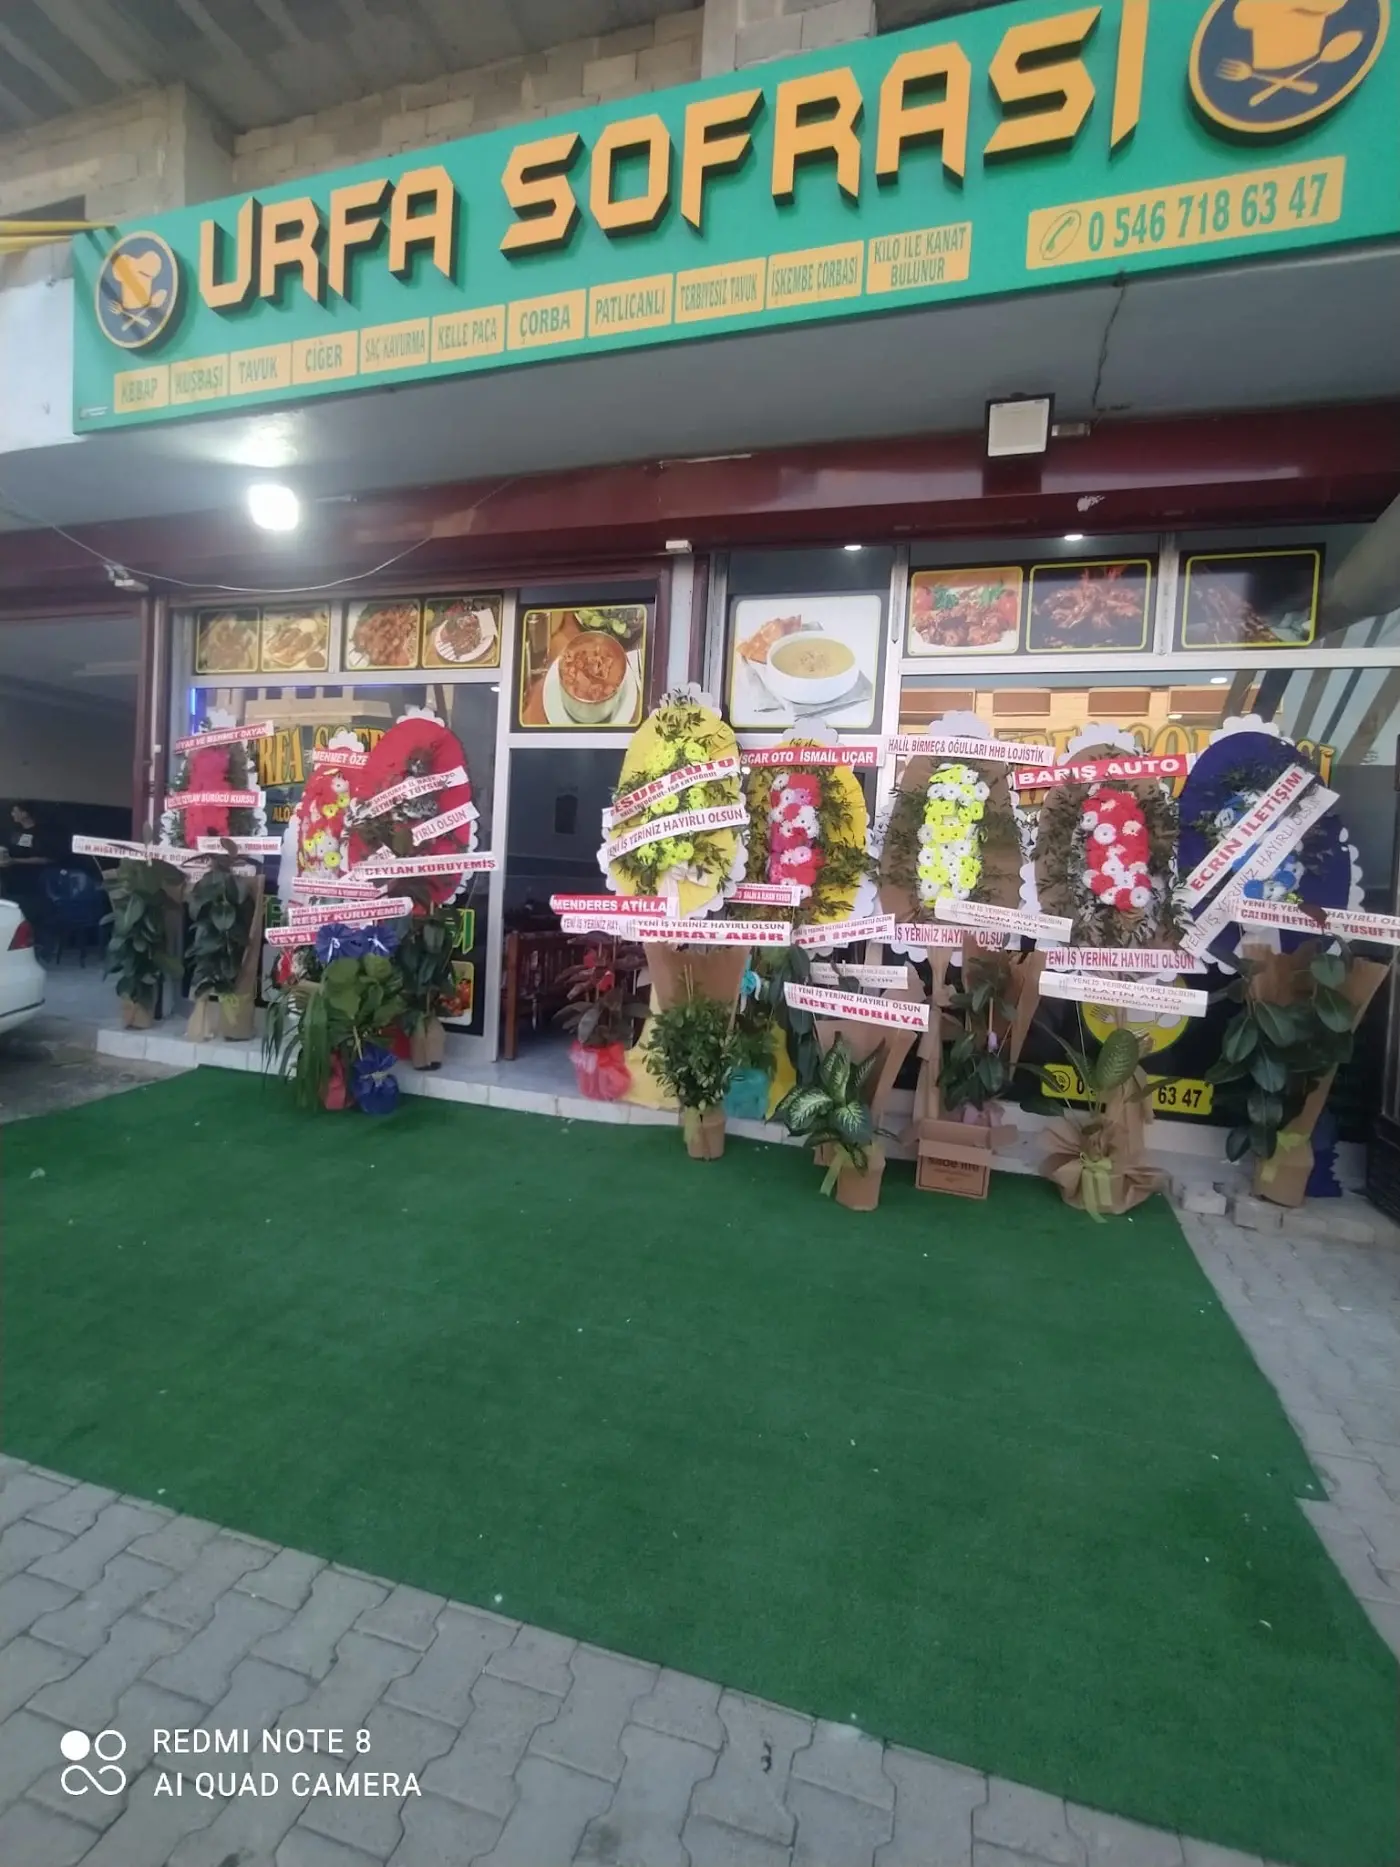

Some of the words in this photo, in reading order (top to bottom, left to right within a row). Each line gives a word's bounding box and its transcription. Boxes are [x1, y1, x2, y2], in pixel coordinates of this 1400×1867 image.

[200, 165, 455, 308] URFA
[501, 0, 1149, 252] SOFRASI
[1088, 211, 1105, 251] 0
[1113, 201, 1166, 248] 546
[1178, 190, 1230, 238] 718
[1241, 181, 1278, 228] 63
[1288, 172, 1328, 220] 47
[926, 226, 967, 255] KANAT
[891, 257, 945, 287] BULUNUR
[730, 272, 757, 303] TAVUK
[595, 286, 665, 325] PATLICANLI
[438, 322, 468, 351] KELLE
[520, 304, 571, 344] ÇORBA
[238, 356, 278, 385] TAVUK
[312, 751, 348, 764] MEHMET
[349, 752, 368, 766] ÖZE
[771, 751, 794, 763] OTO
[799, 748, 839, 763] İSMAİL
[842, 751, 874, 766] UÇAR
[888, 738, 909, 751] HALİL
[947, 739, 987, 756] OĞULLARI
[989, 745, 1006, 758] HHB
[1007, 746, 1045, 763] LOJİSTİK
[670, 757, 735, 784] AUTO
[1018, 764, 1097, 786] BARIŞ
[1107, 758, 1180, 776] AUTO
[438, 809, 467, 831] OLSUN
[629, 822, 661, 845] YERİNİZ
[663, 813, 705, 832] HAYIRLI
[708, 808, 743, 824] OLSUN
[1190, 837, 1243, 891] ECRİN
[1241, 770, 1304, 838] İLETİŞİM
[1256, 823, 1296, 867] HAYIRLI
[364, 864, 415, 876] CEYLAN
[419, 858, 496, 873] KURUYEMİŞ
[552, 898, 618, 911] MENDERES
[620, 898, 667, 913] ATİLLA
[638, 918, 659, 927] YENİ
[671, 920, 708, 928] YERİNİZ
[711, 922, 749, 930] HAYIRLI
[639, 929, 719, 940] MURAT
[904, 926, 939, 943] YERİNİZ
[1282, 913, 1332, 931] İLETİŞM
[1343, 923, 1386, 937] YUSUF
[1079, 950, 1119, 968] YERİNİZ
[1120, 953, 1159, 969] HAYIRLI
[1161, 954, 1195, 970] OLSUN
[798, 987, 814, 995] YENİ
[824, 990, 855, 1002] YERİNİZ
[856, 996, 889, 1008] HAYIRLI
[892, 1003, 921, 1013] OLSUN
[842, 1005, 925, 1027] MOBİLYA
[1157, 1087, 1177, 1106] 63
[1181, 1089, 1203, 1108] 47
